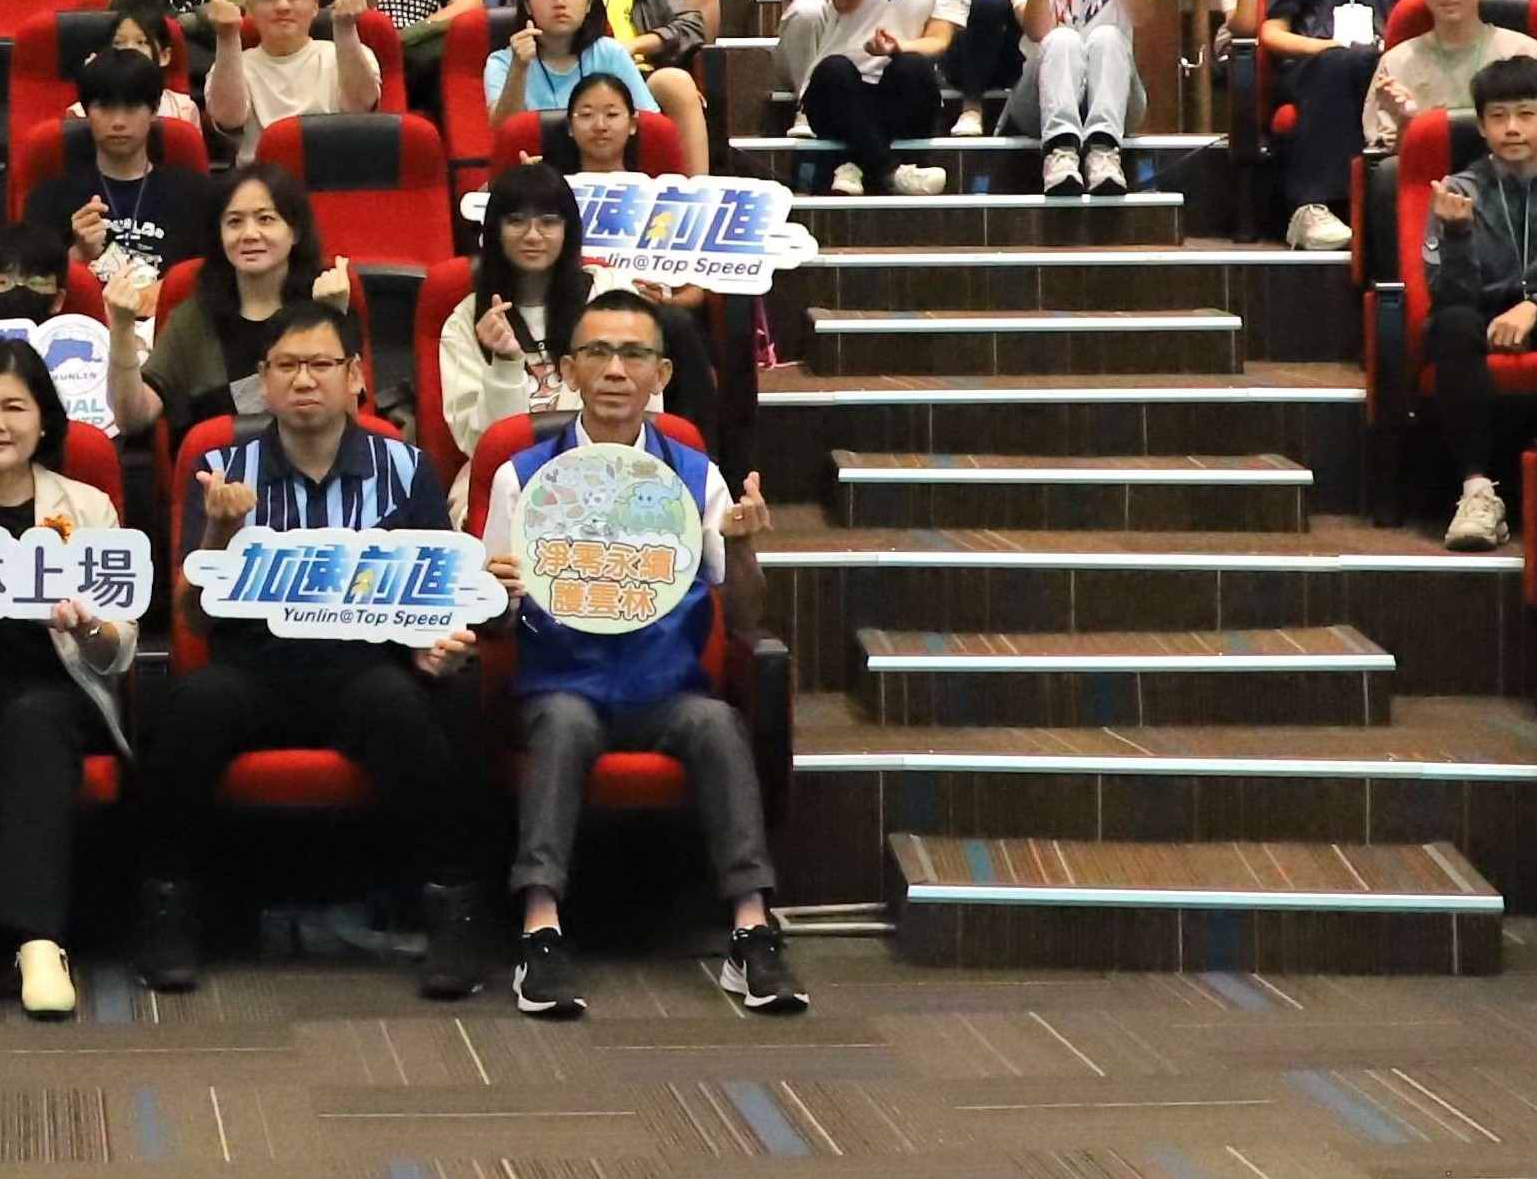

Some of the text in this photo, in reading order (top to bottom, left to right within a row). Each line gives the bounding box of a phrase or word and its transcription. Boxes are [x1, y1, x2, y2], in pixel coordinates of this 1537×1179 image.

[576, 184, 773, 254] 速前進
[694, 257, 763, 277] Speed
[227, 542, 467, 606] 加速前進
[283, 606, 453, 627] Yunlin@Top Speed
